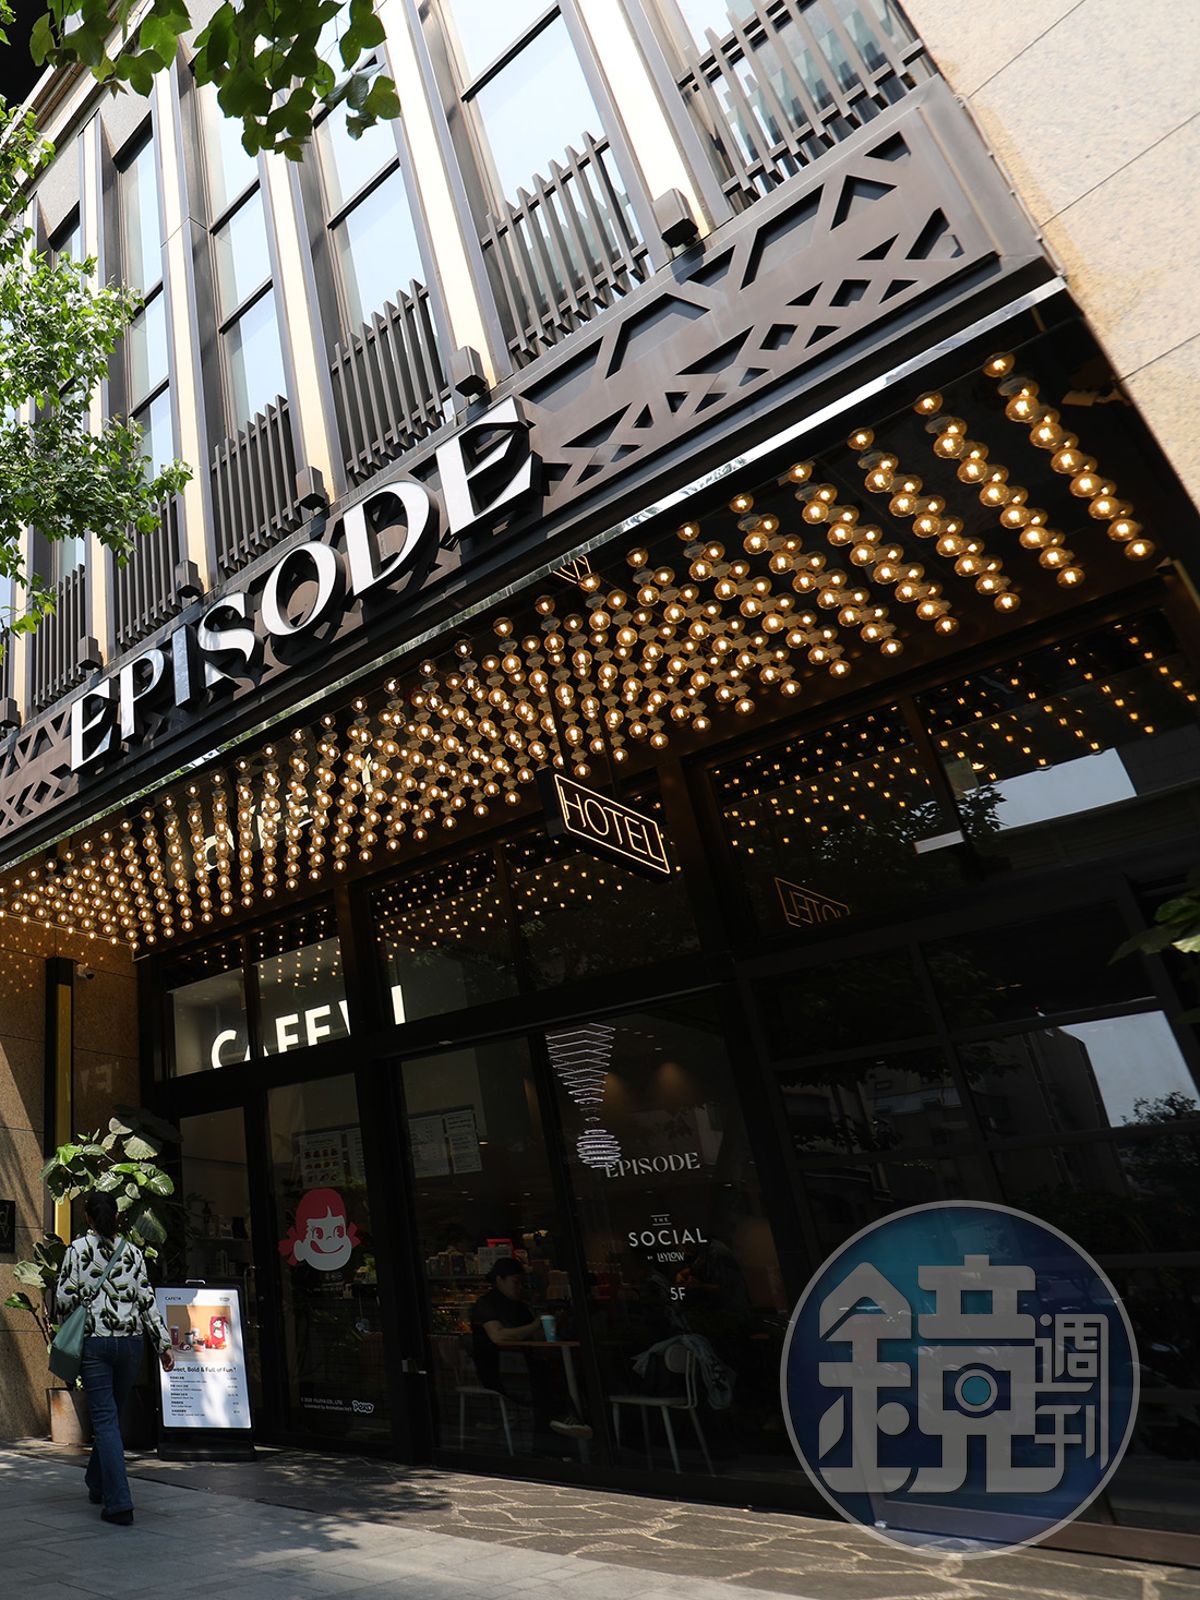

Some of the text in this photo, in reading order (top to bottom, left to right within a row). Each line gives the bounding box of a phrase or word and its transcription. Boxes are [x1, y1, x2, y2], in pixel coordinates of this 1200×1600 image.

[70, 396, 534, 773] EPISODE
[560, 785, 664, 862] HOTEL
[605, 1152, 701, 1178] EPISODE
[628, 1228, 708, 1247] SOCIAL
